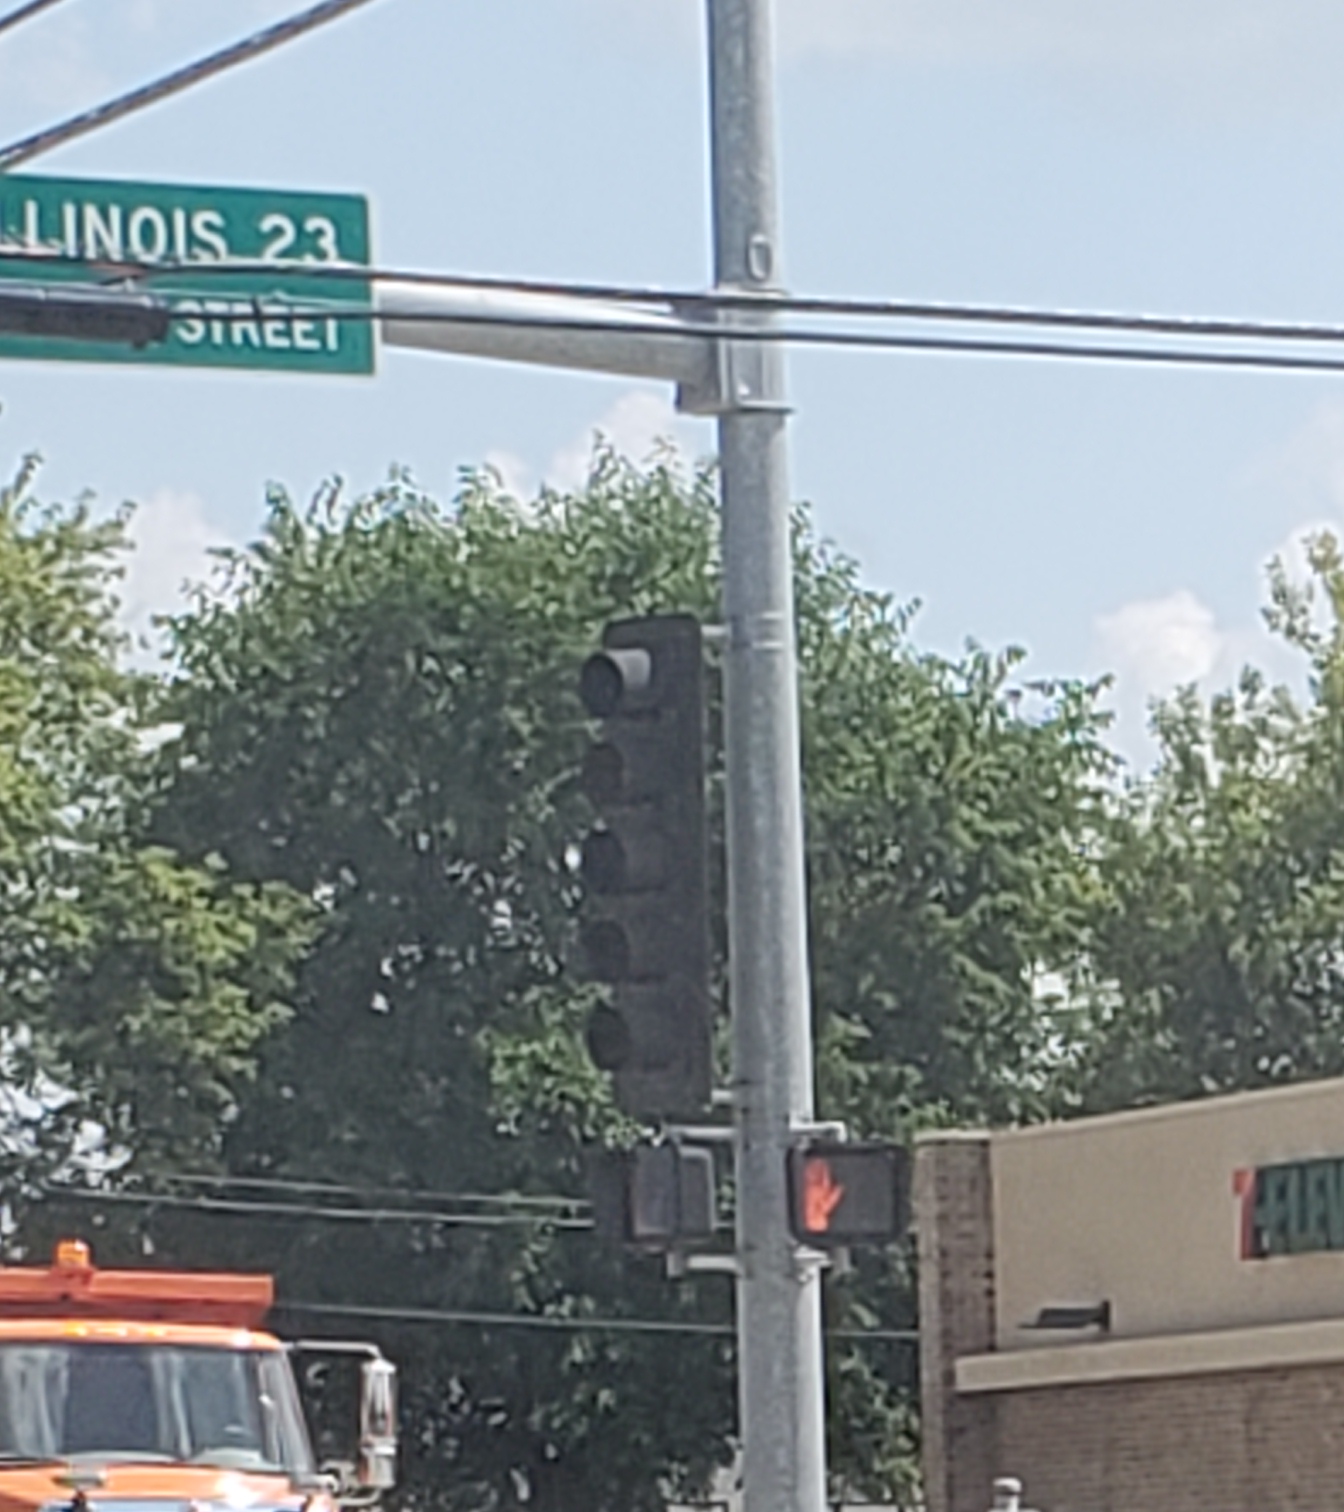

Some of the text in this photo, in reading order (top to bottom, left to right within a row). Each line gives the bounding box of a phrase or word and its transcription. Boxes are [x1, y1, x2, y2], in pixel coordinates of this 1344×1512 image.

[0, 199, 340, 264] LINOIS 23
[176, 300, 340, 351] STREET
